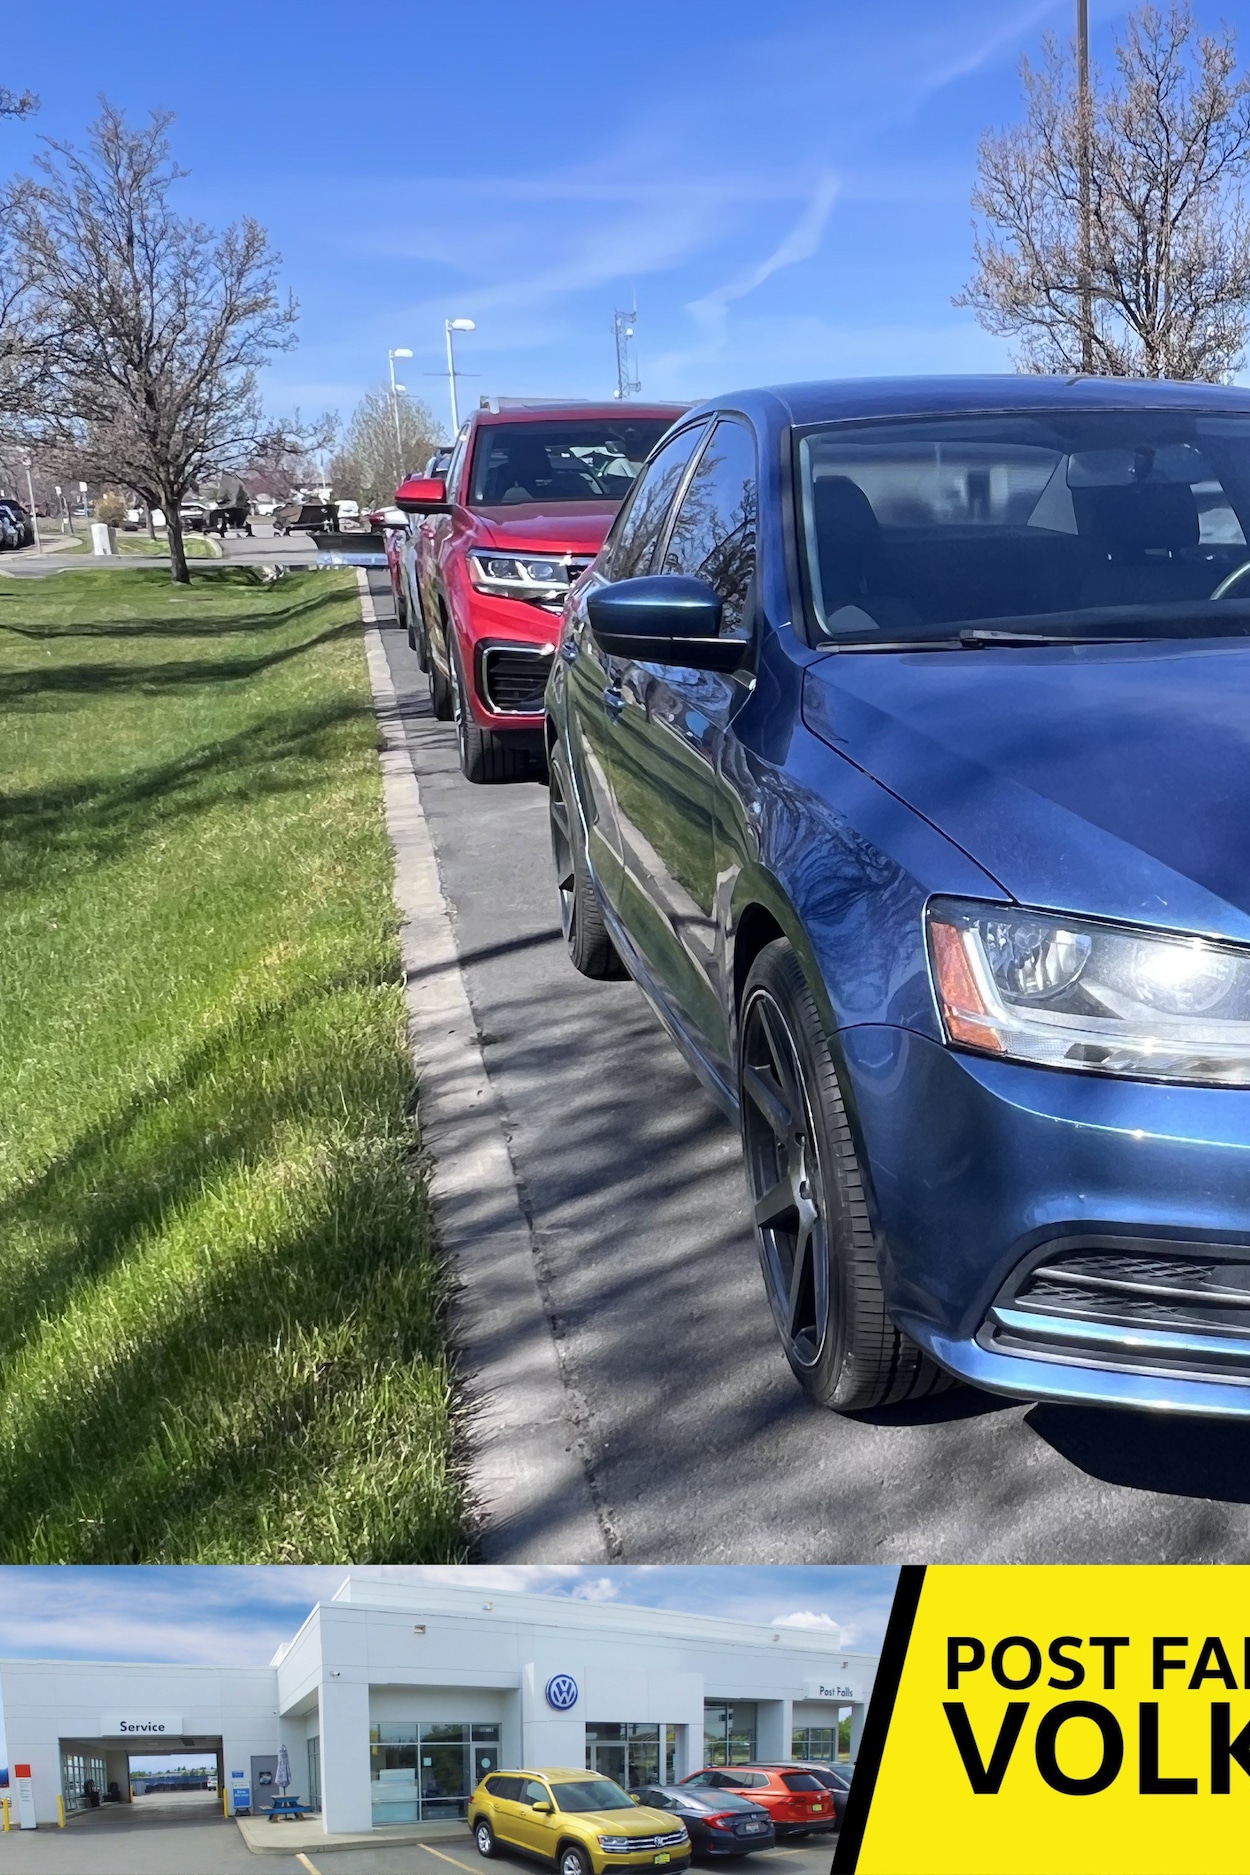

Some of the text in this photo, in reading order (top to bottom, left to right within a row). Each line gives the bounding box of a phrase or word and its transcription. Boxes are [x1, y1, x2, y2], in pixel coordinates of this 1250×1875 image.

[546, 1673, 579, 1711] VW
[819, 1685, 854, 1698] Post Falls
[120, 1721, 165, 1732] Service
